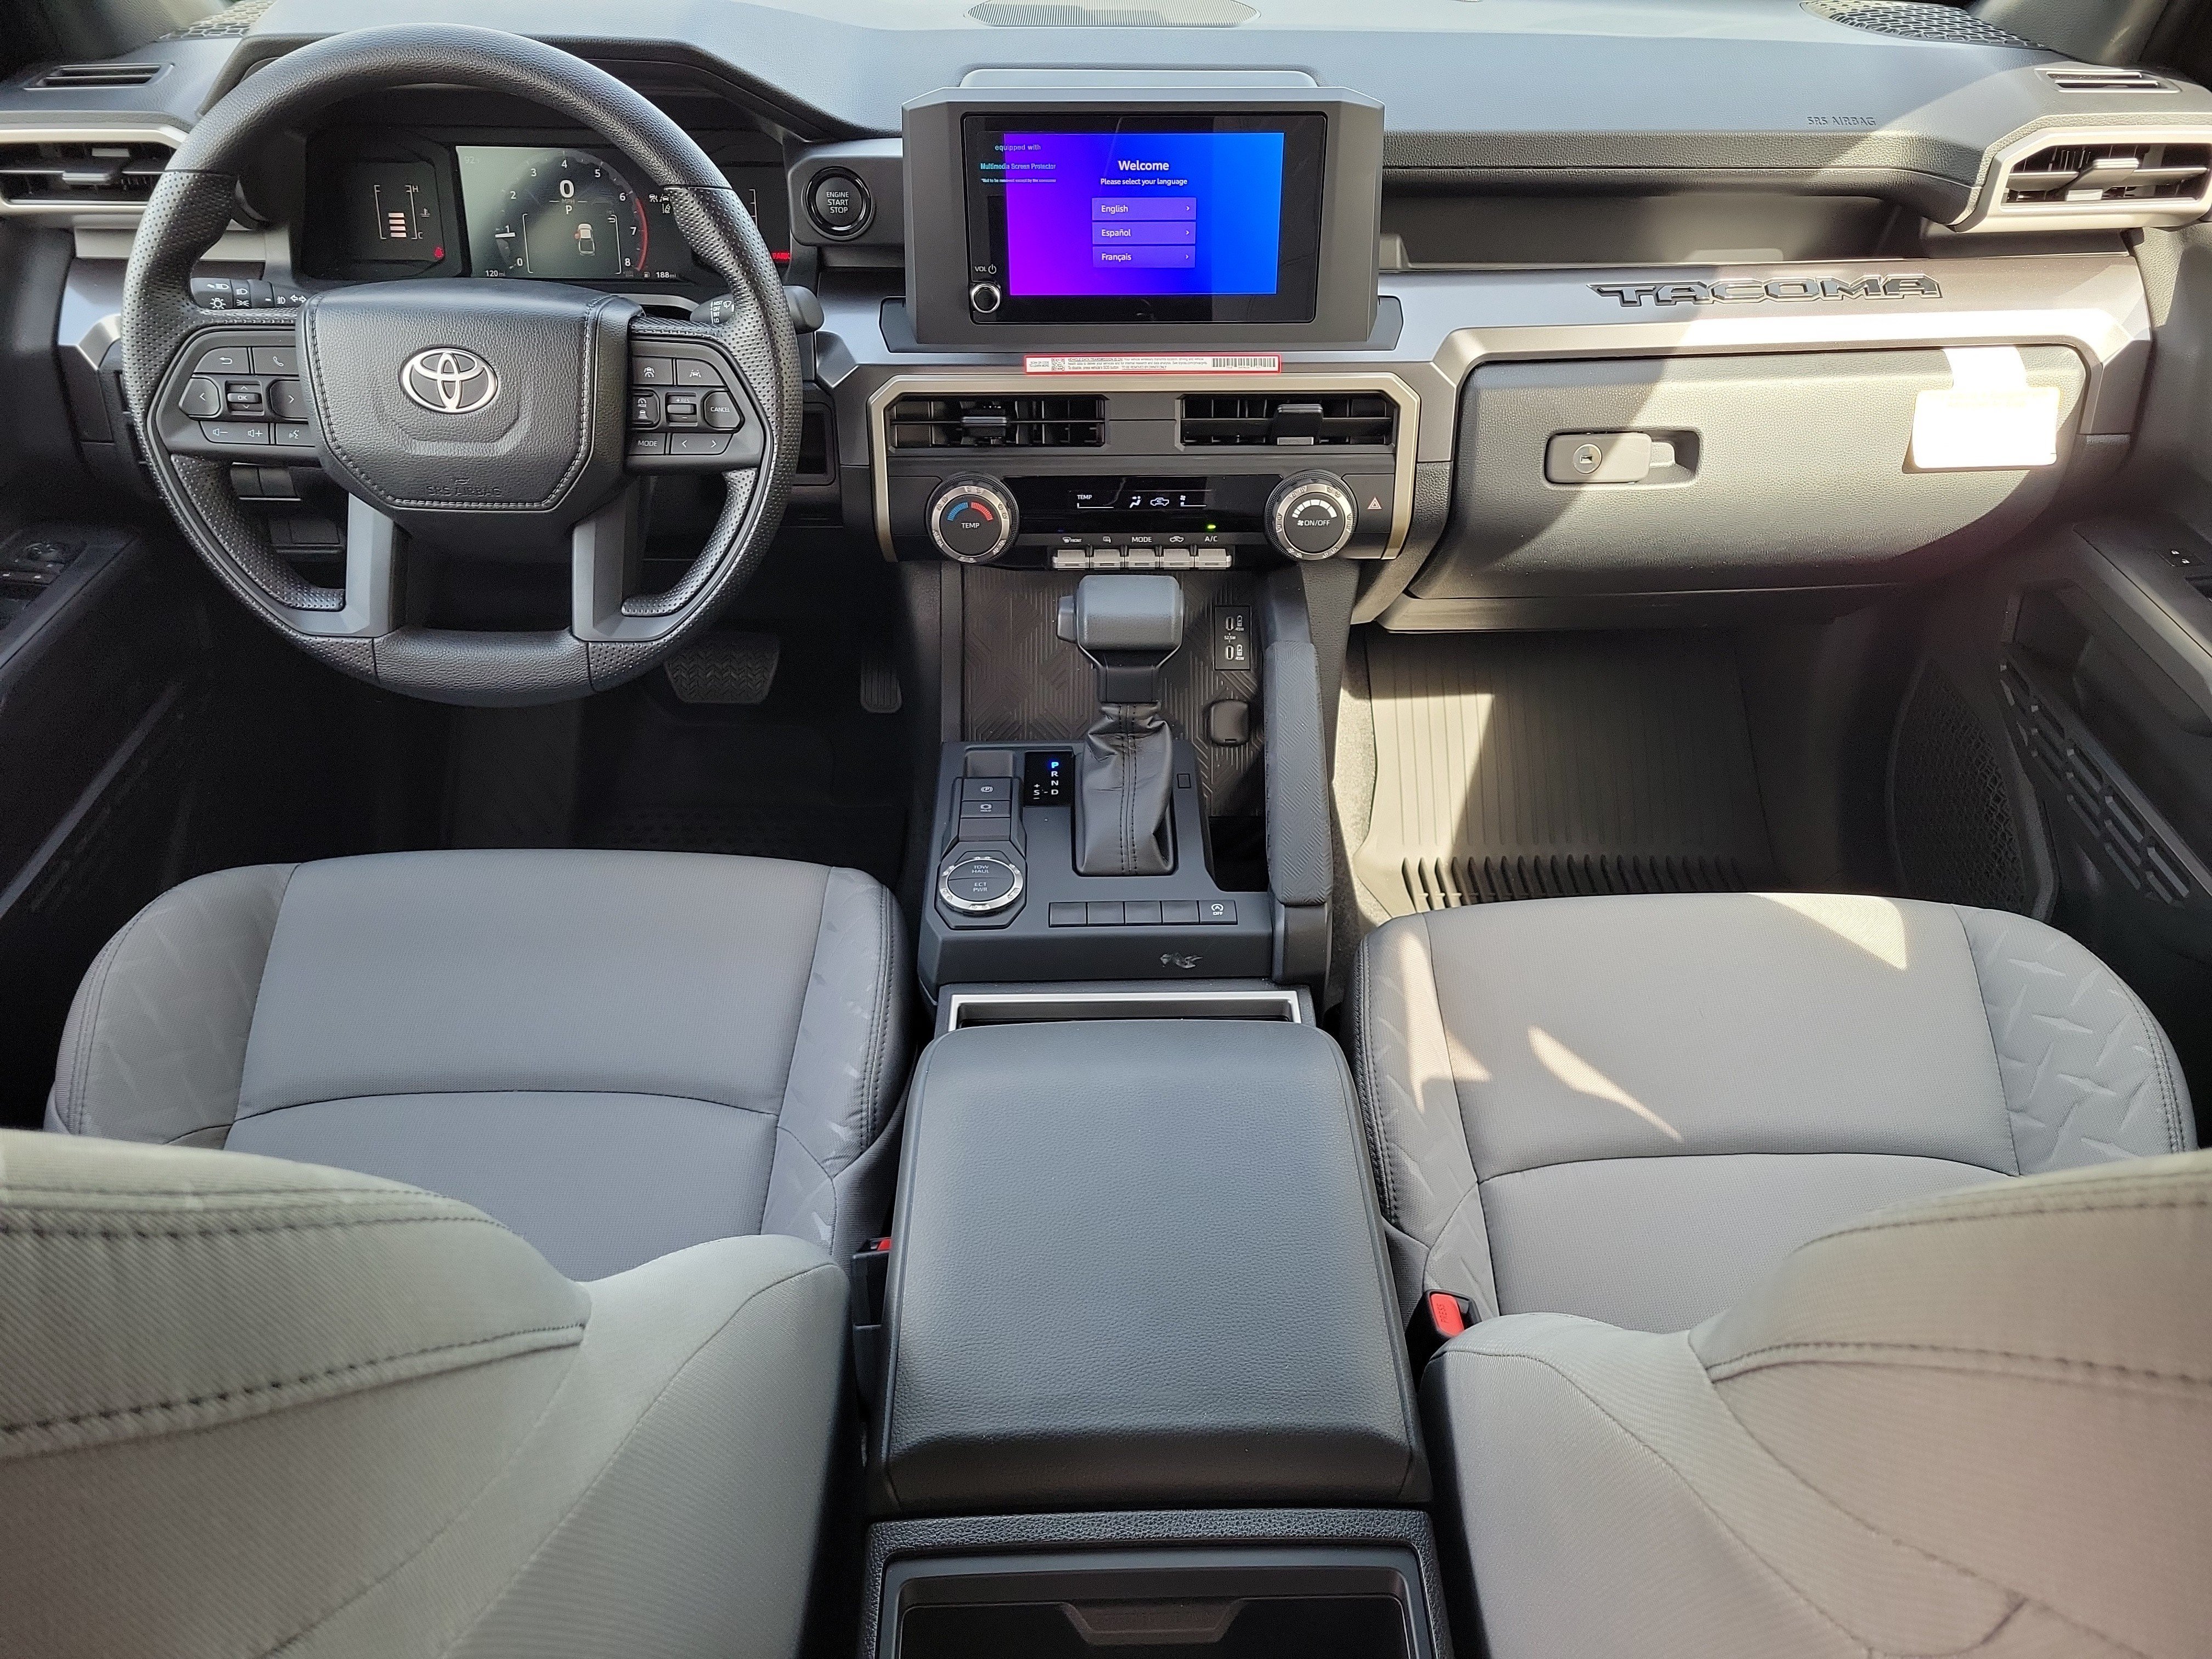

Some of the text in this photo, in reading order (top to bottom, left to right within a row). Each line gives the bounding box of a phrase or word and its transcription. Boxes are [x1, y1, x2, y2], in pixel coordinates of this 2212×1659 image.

[1807, 116, 1876, 126] SRS AIRBAG
[561, 160, 568, 168] 4
[1118, 160, 1170, 171] Welcome
[531, 168, 537, 177] 3
[595, 168, 601, 178] 5
[560, 179, 574, 198] 0
[510, 191, 517, 199] 2
[619, 193, 626, 201] 6
[566, 205, 572, 215] P
[1101, 205, 1128, 214] English
[505, 225, 510, 233] 1
[630, 227, 637, 235] 7
[1101, 229, 1131, 238] Español
[517, 258, 523, 266] 0
[1102, 253, 1132, 262] Français
[625, 258, 631, 267] 8
[1587, 274, 1943, 307] TACOMA
[1436, 1302, 1448, 1324] PRESS
